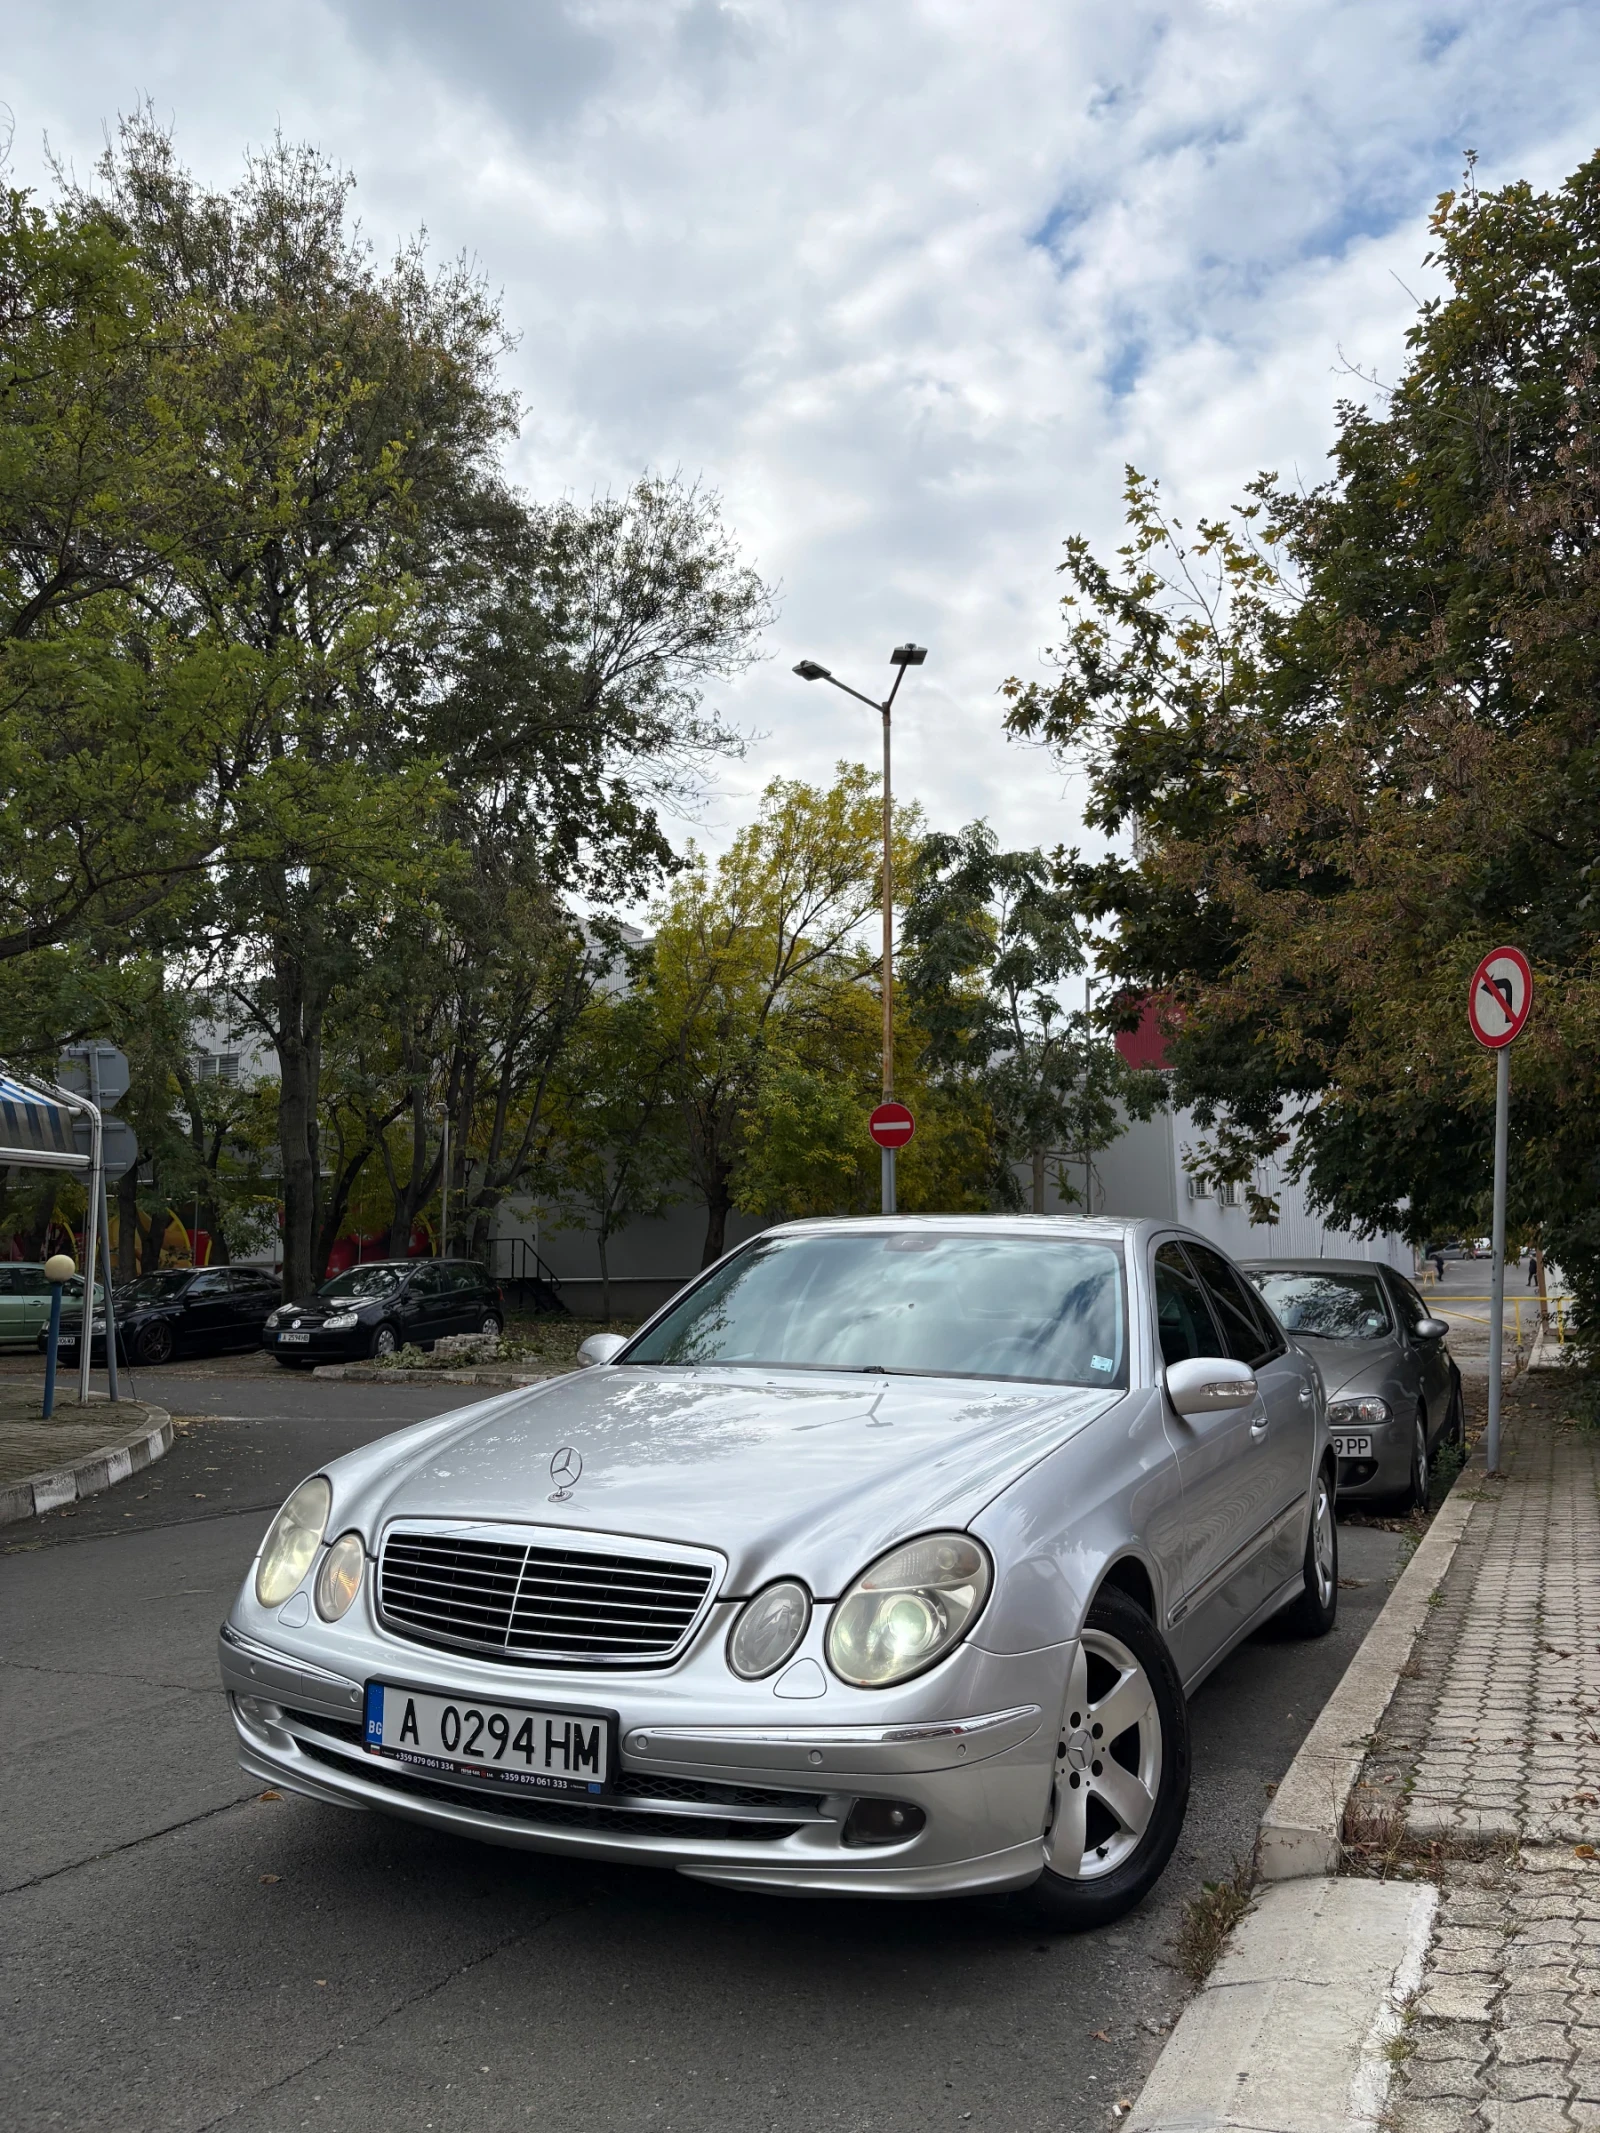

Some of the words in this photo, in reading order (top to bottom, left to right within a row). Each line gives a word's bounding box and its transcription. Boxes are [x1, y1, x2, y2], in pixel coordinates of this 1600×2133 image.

[1346, 1438, 1368, 1454] PP
[368, 1720, 382, 1735] BG
[399, 1698, 420, 1746] A
[395, 1752, 412, 1762] +359
[413, 1755, 426, 1765] 879
[426, 1759, 439, 1769] 061
[440, 1761, 454, 1771] 334
[500, 1772, 519, 1782] +359
[520, 1774, 535, 1784] 879
[536, 1777, 550, 1787] 061
[552, 1779, 568, 1789] 333
